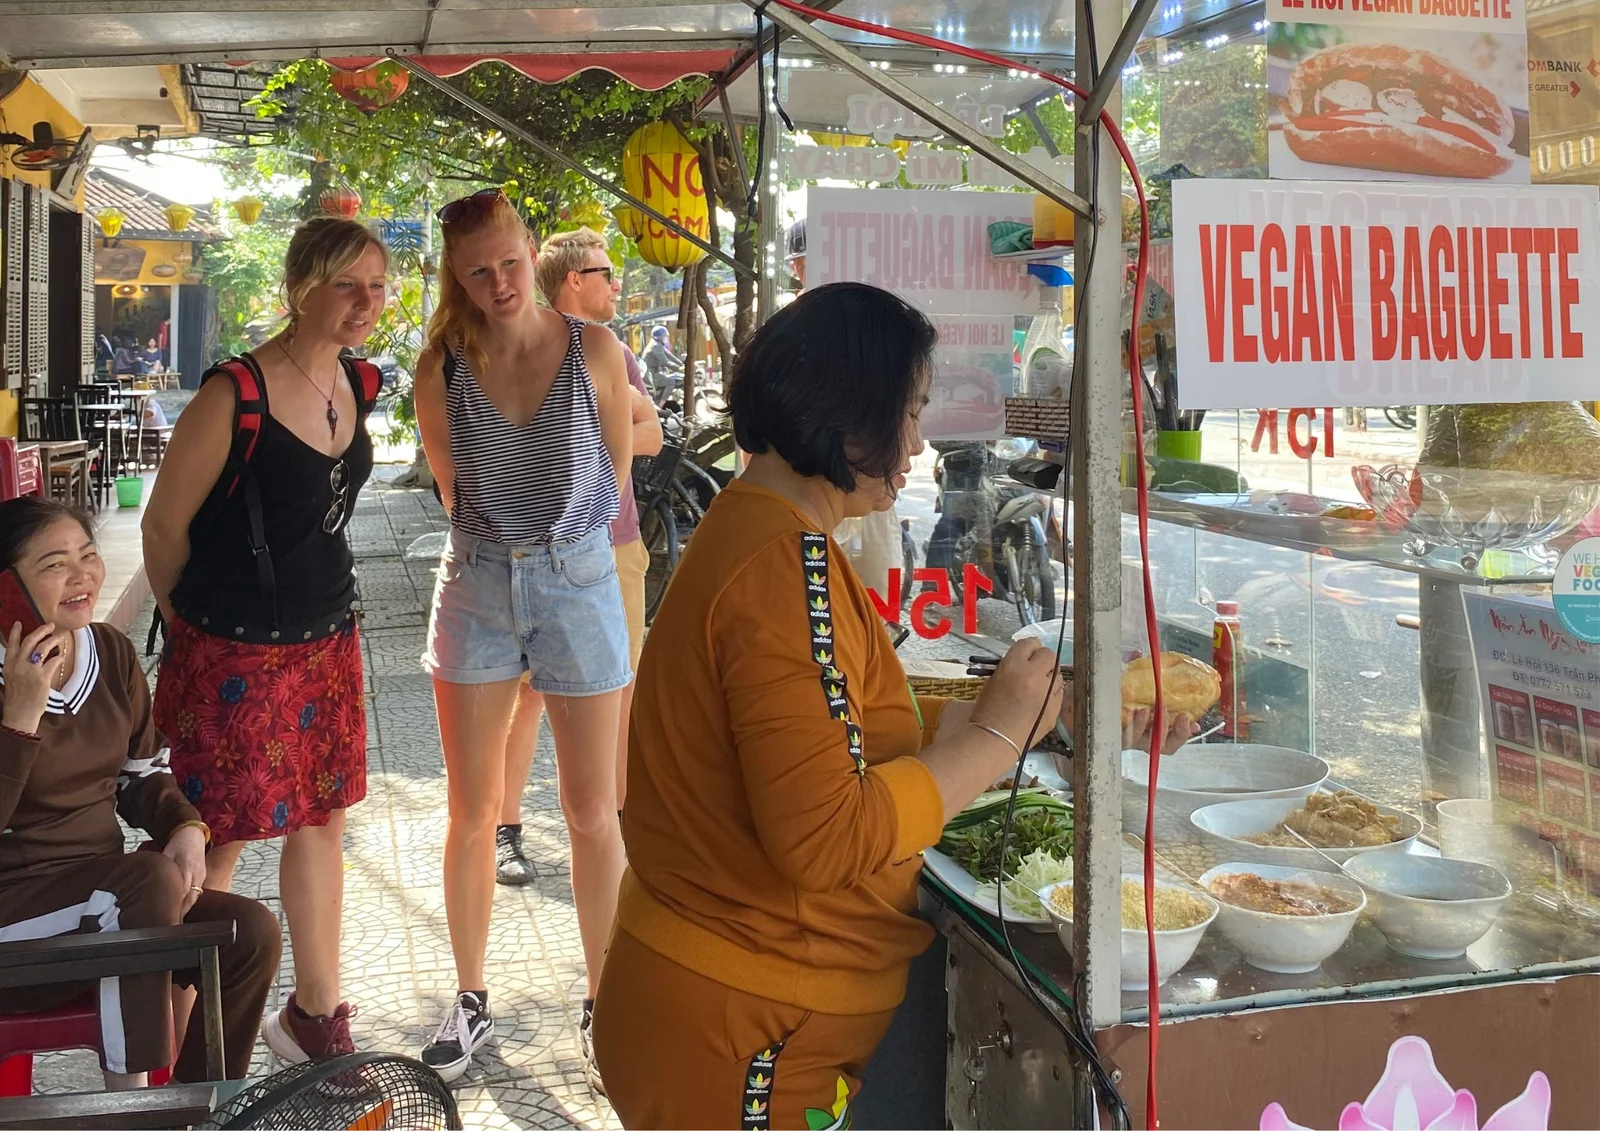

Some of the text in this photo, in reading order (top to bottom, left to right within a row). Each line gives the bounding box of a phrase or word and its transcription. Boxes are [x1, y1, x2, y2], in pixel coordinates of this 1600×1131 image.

[1535, 84, 1569, 92] GREATER
[1199, 223, 1584, 363] VEGAN BAGUETTE
[1574, 552, 1591, 564] WE
[1530, 676, 1552, 689] 0772
